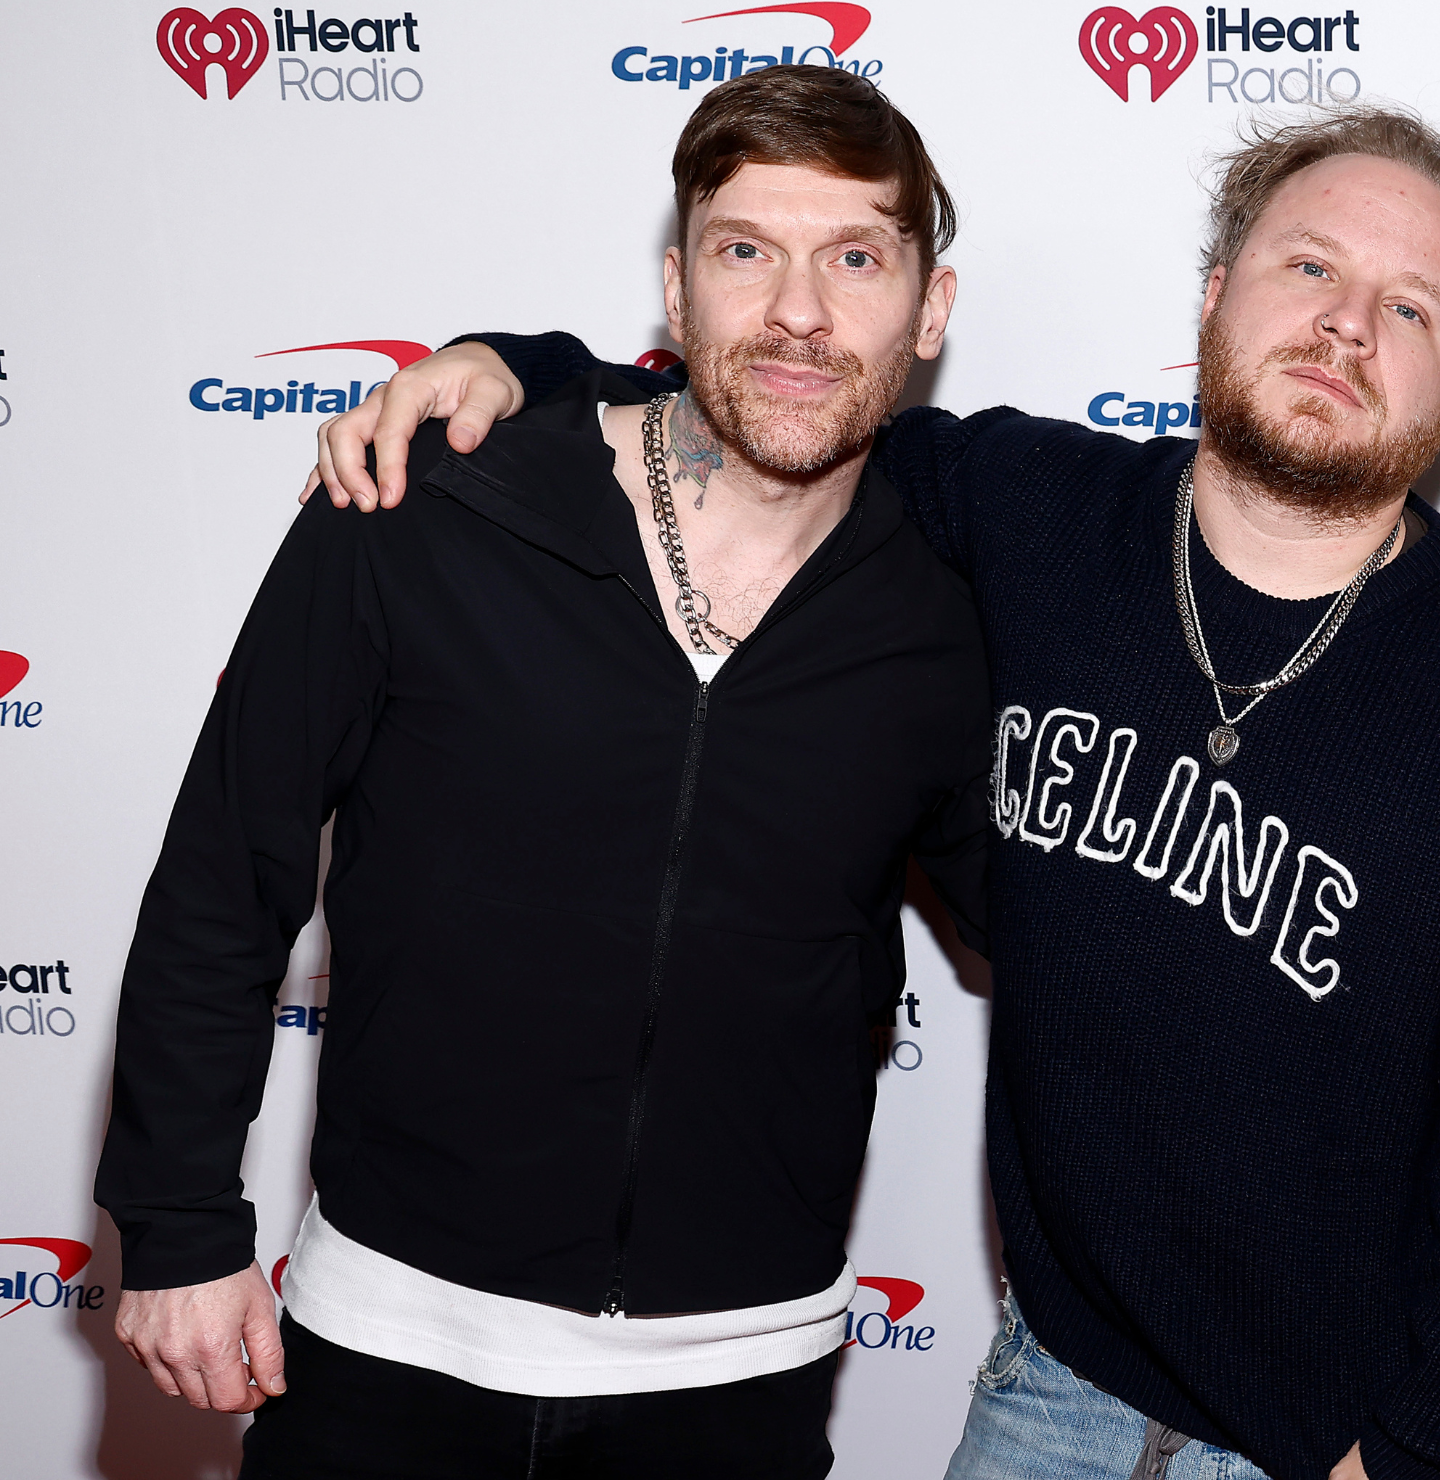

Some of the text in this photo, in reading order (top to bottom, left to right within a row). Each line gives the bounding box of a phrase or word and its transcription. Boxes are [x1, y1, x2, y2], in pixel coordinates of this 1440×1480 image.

[273, 7, 421, 53] iHeart
[1206, 5, 1360, 53] iHeart
[278, 57, 424, 102] Radio
[1207, 57, 1361, 103] Radio
[189, 377, 388, 420] Capital
[992, 704, 1359, 1001] CELINE
